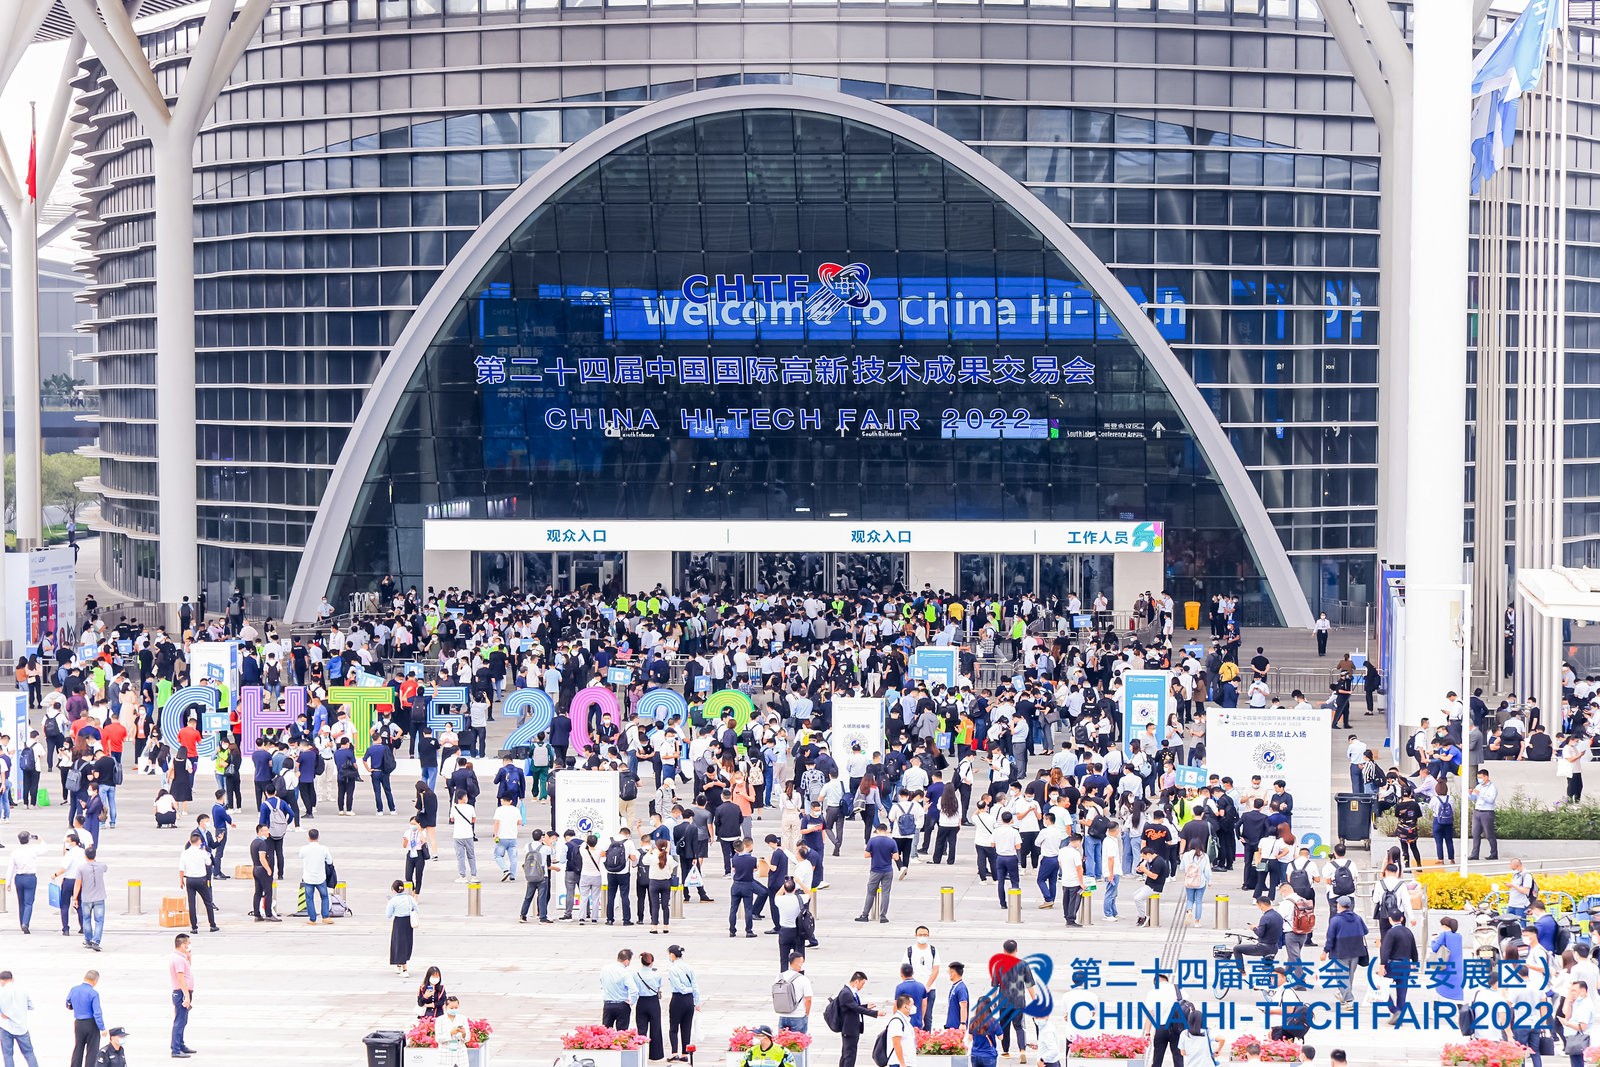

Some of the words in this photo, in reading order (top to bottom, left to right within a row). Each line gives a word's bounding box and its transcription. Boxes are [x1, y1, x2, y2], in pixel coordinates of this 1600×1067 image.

[682, 274, 809, 303] CHTF
[902, 291, 1017, 325] China
[474, 355, 1096, 387] 第二十四届中国国际高新技术成果交易会
[545, 408, 660, 430] CHINA
[681, 408, 821, 430] HI-TECH
[839, 408, 921, 430] FAIR
[942, 408, 1031, 430] 2022
[546, 528, 607, 543] 观众入口
[851, 529, 912, 543] 观众入口
[1067, 531, 1129, 544] 工作人员
